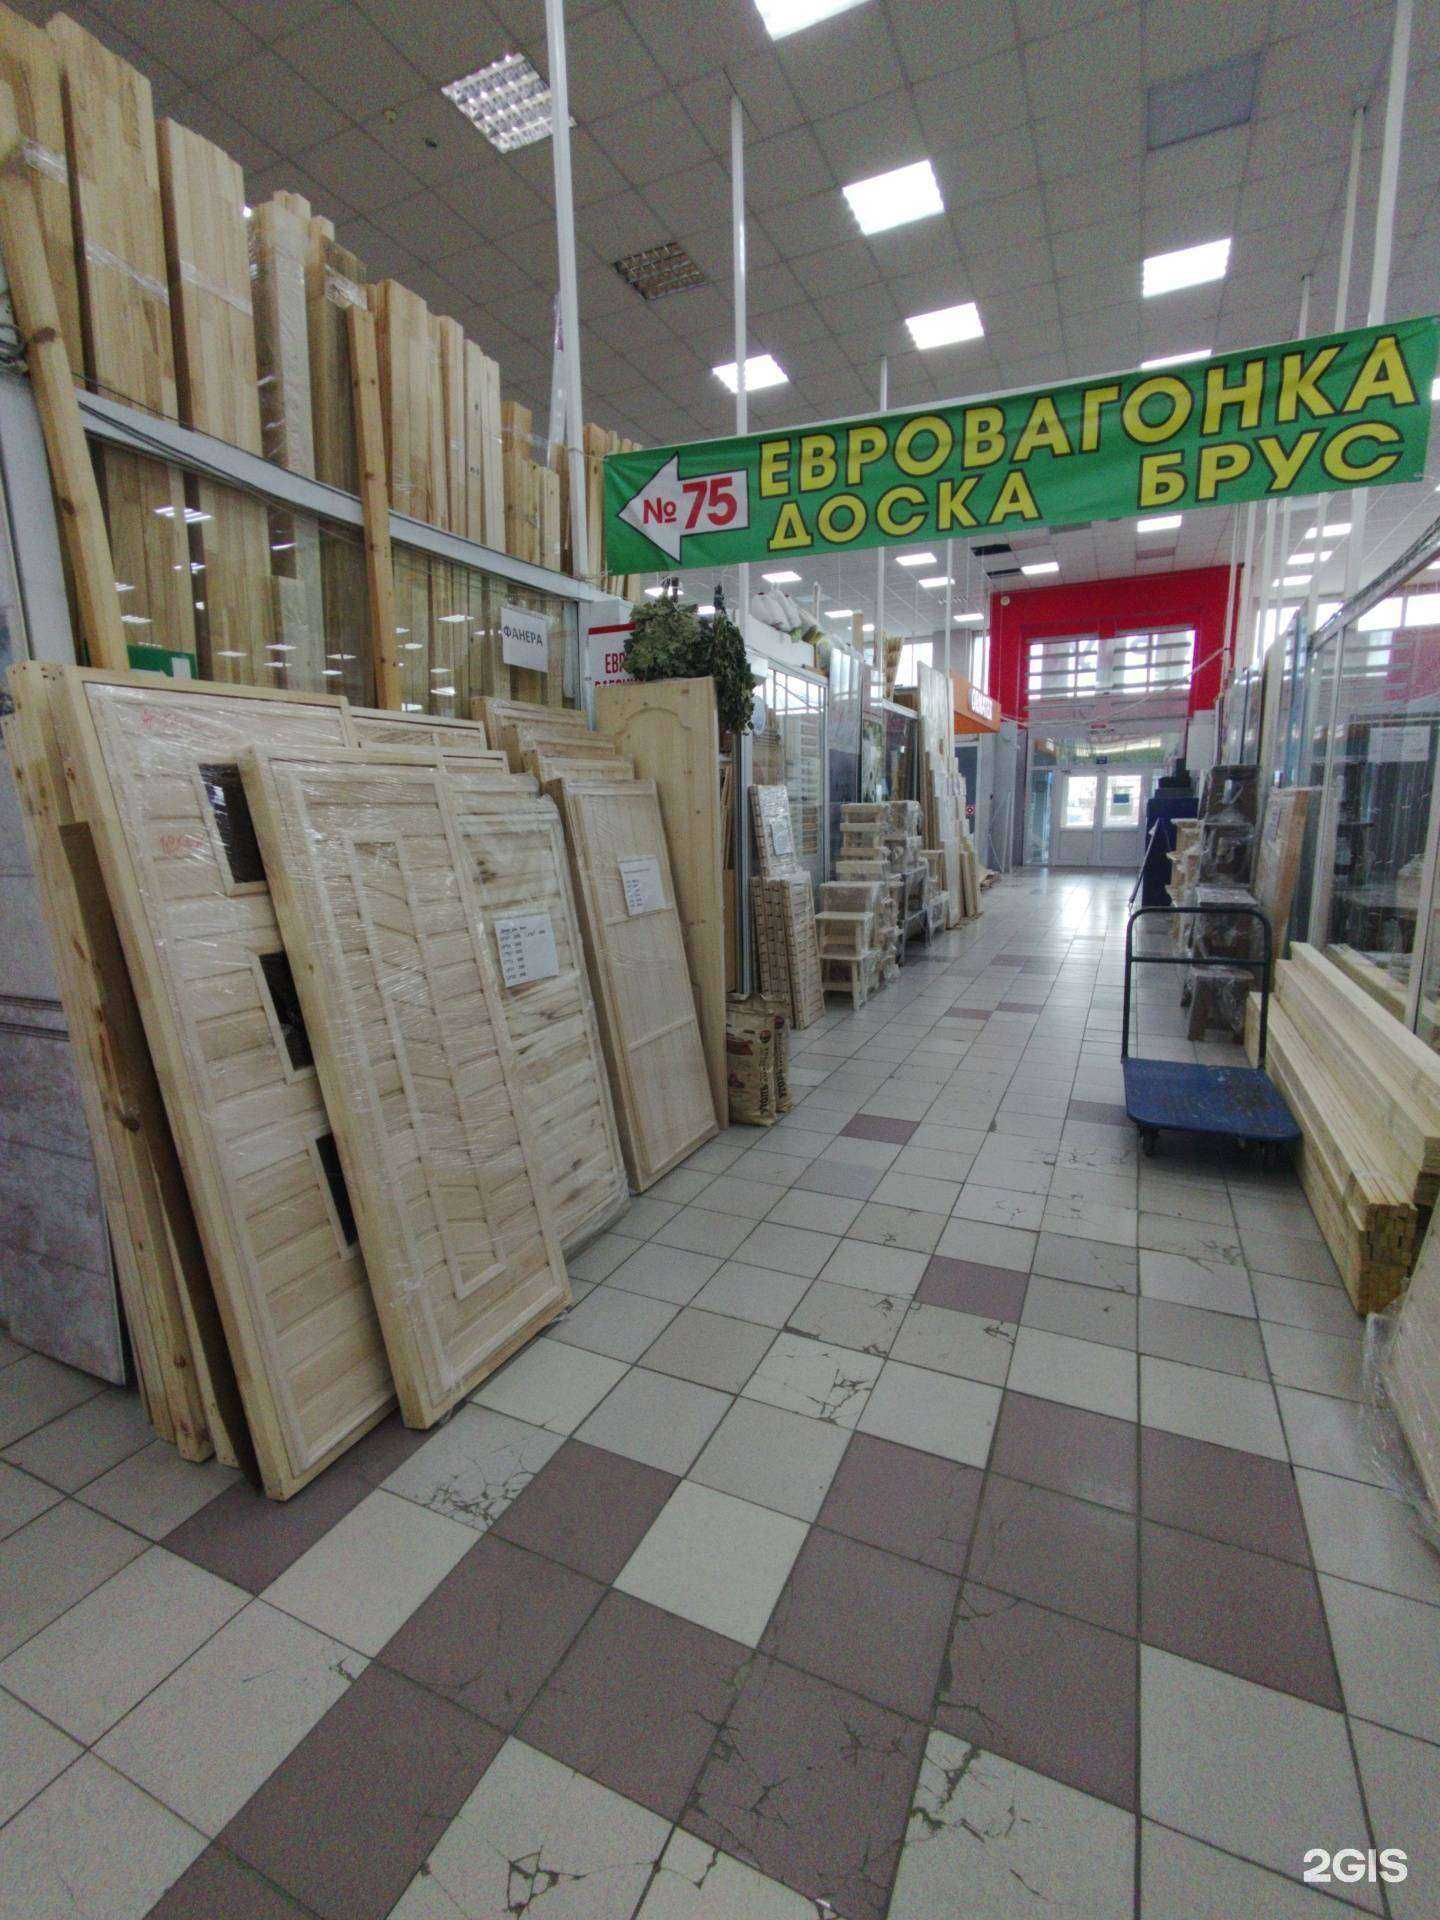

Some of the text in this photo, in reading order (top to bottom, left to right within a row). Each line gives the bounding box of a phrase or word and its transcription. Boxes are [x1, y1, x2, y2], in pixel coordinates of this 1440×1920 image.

[759, 333, 1418, 499] ЕВРОВАГОНКА
[768, 419, 1404, 552] ДОСКА БРУС
[503, 625, 543, 647] ФАНЕРА
[605, 652, 630, 674] ЕВР
